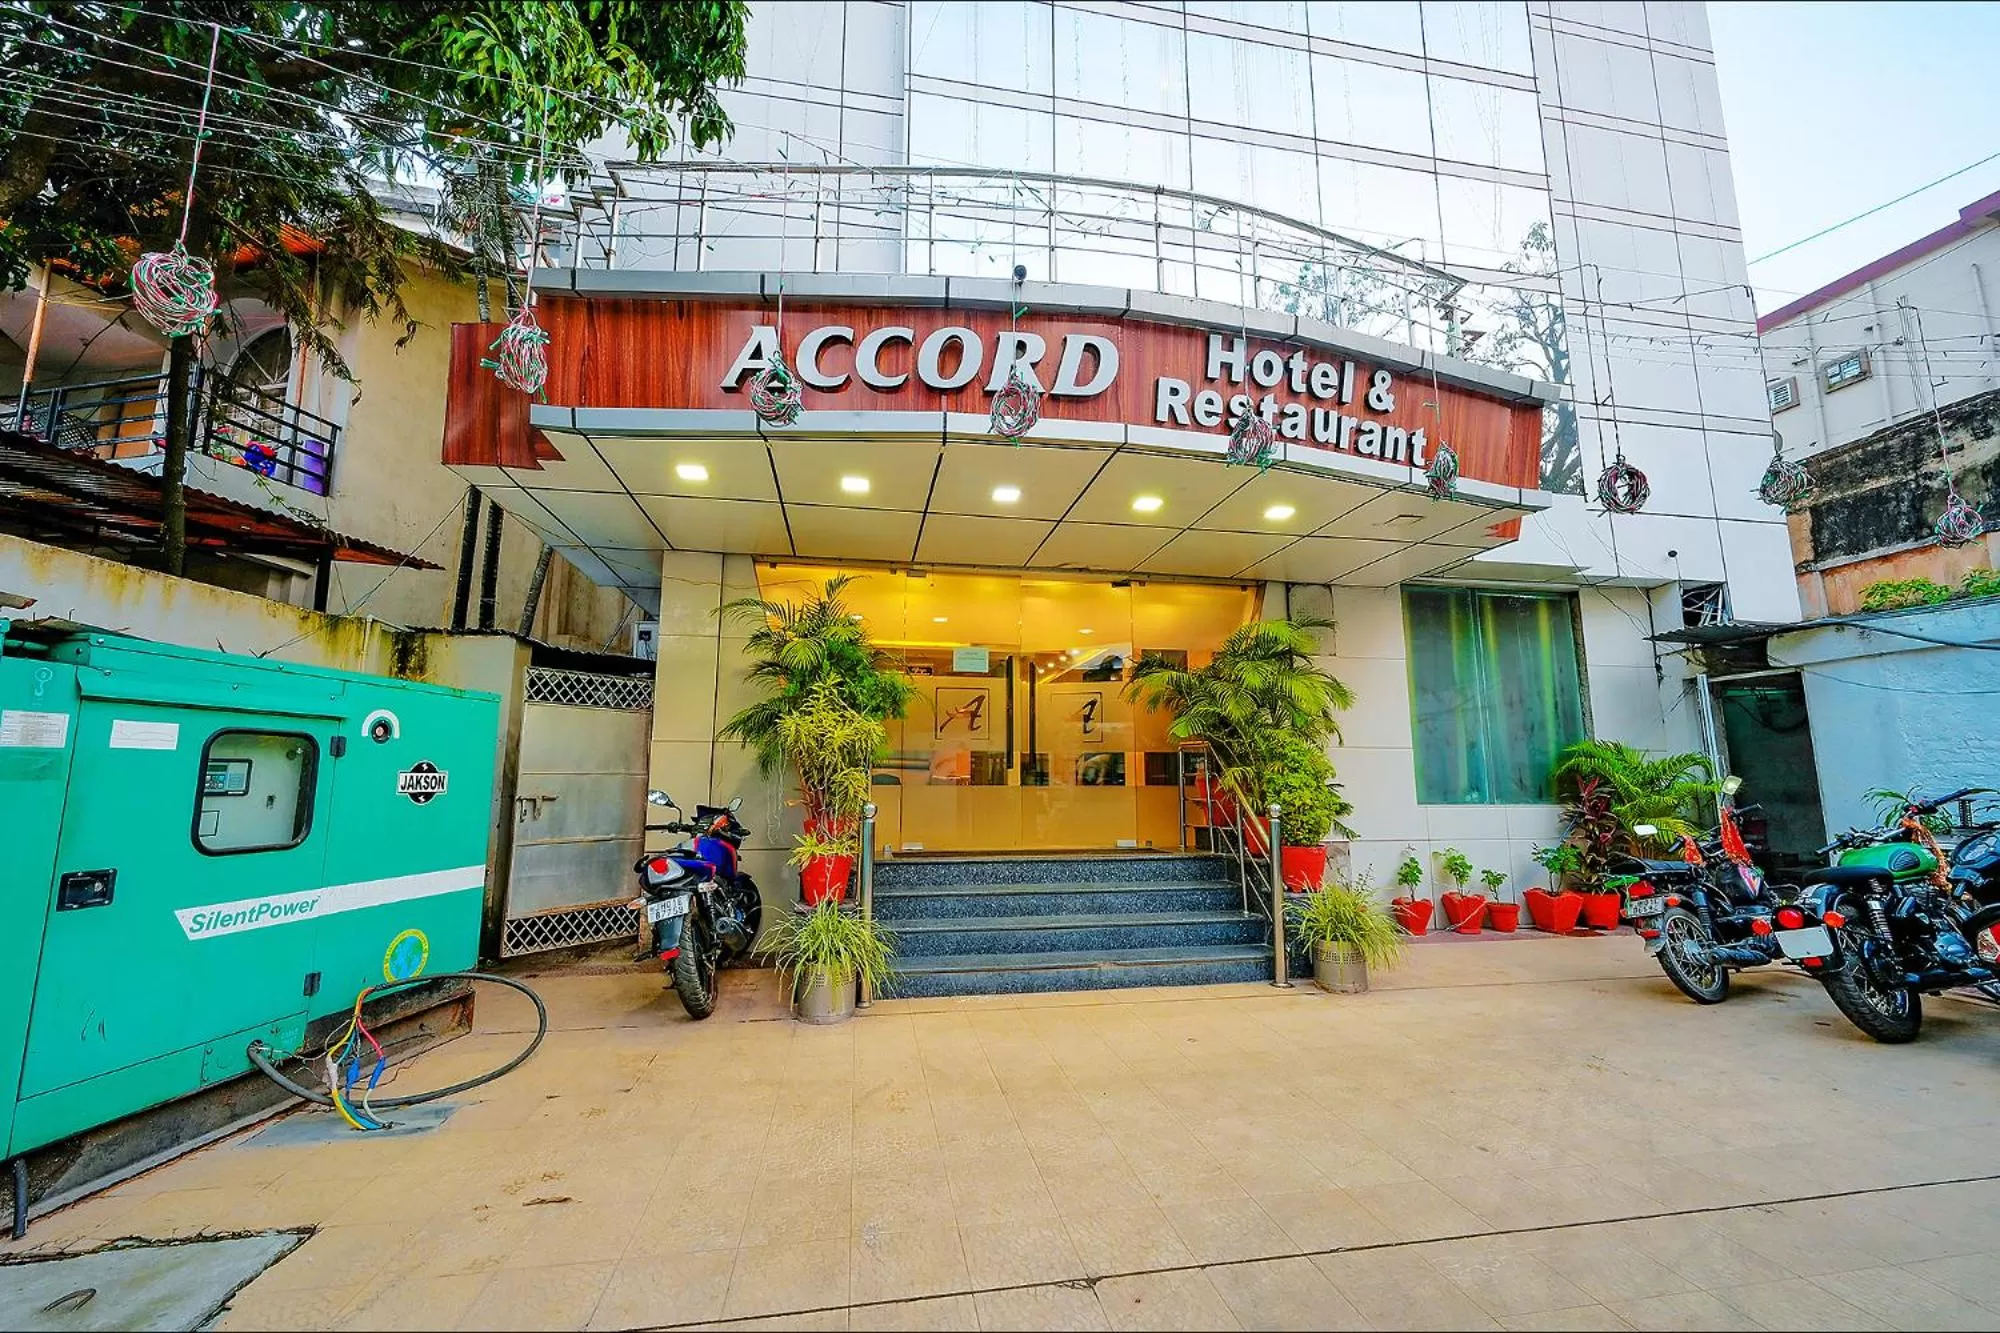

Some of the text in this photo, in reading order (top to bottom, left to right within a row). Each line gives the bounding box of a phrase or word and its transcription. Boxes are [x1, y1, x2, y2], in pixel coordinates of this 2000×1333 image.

[720, 325, 1120, 398] ACCORD
[1206, 334, 1396, 414] Hotel &
[1155, 376, 1428, 467] Restaurant
[400, 775, 446, 791] JAKSON
[189, 897, 320, 934] SilentPower
